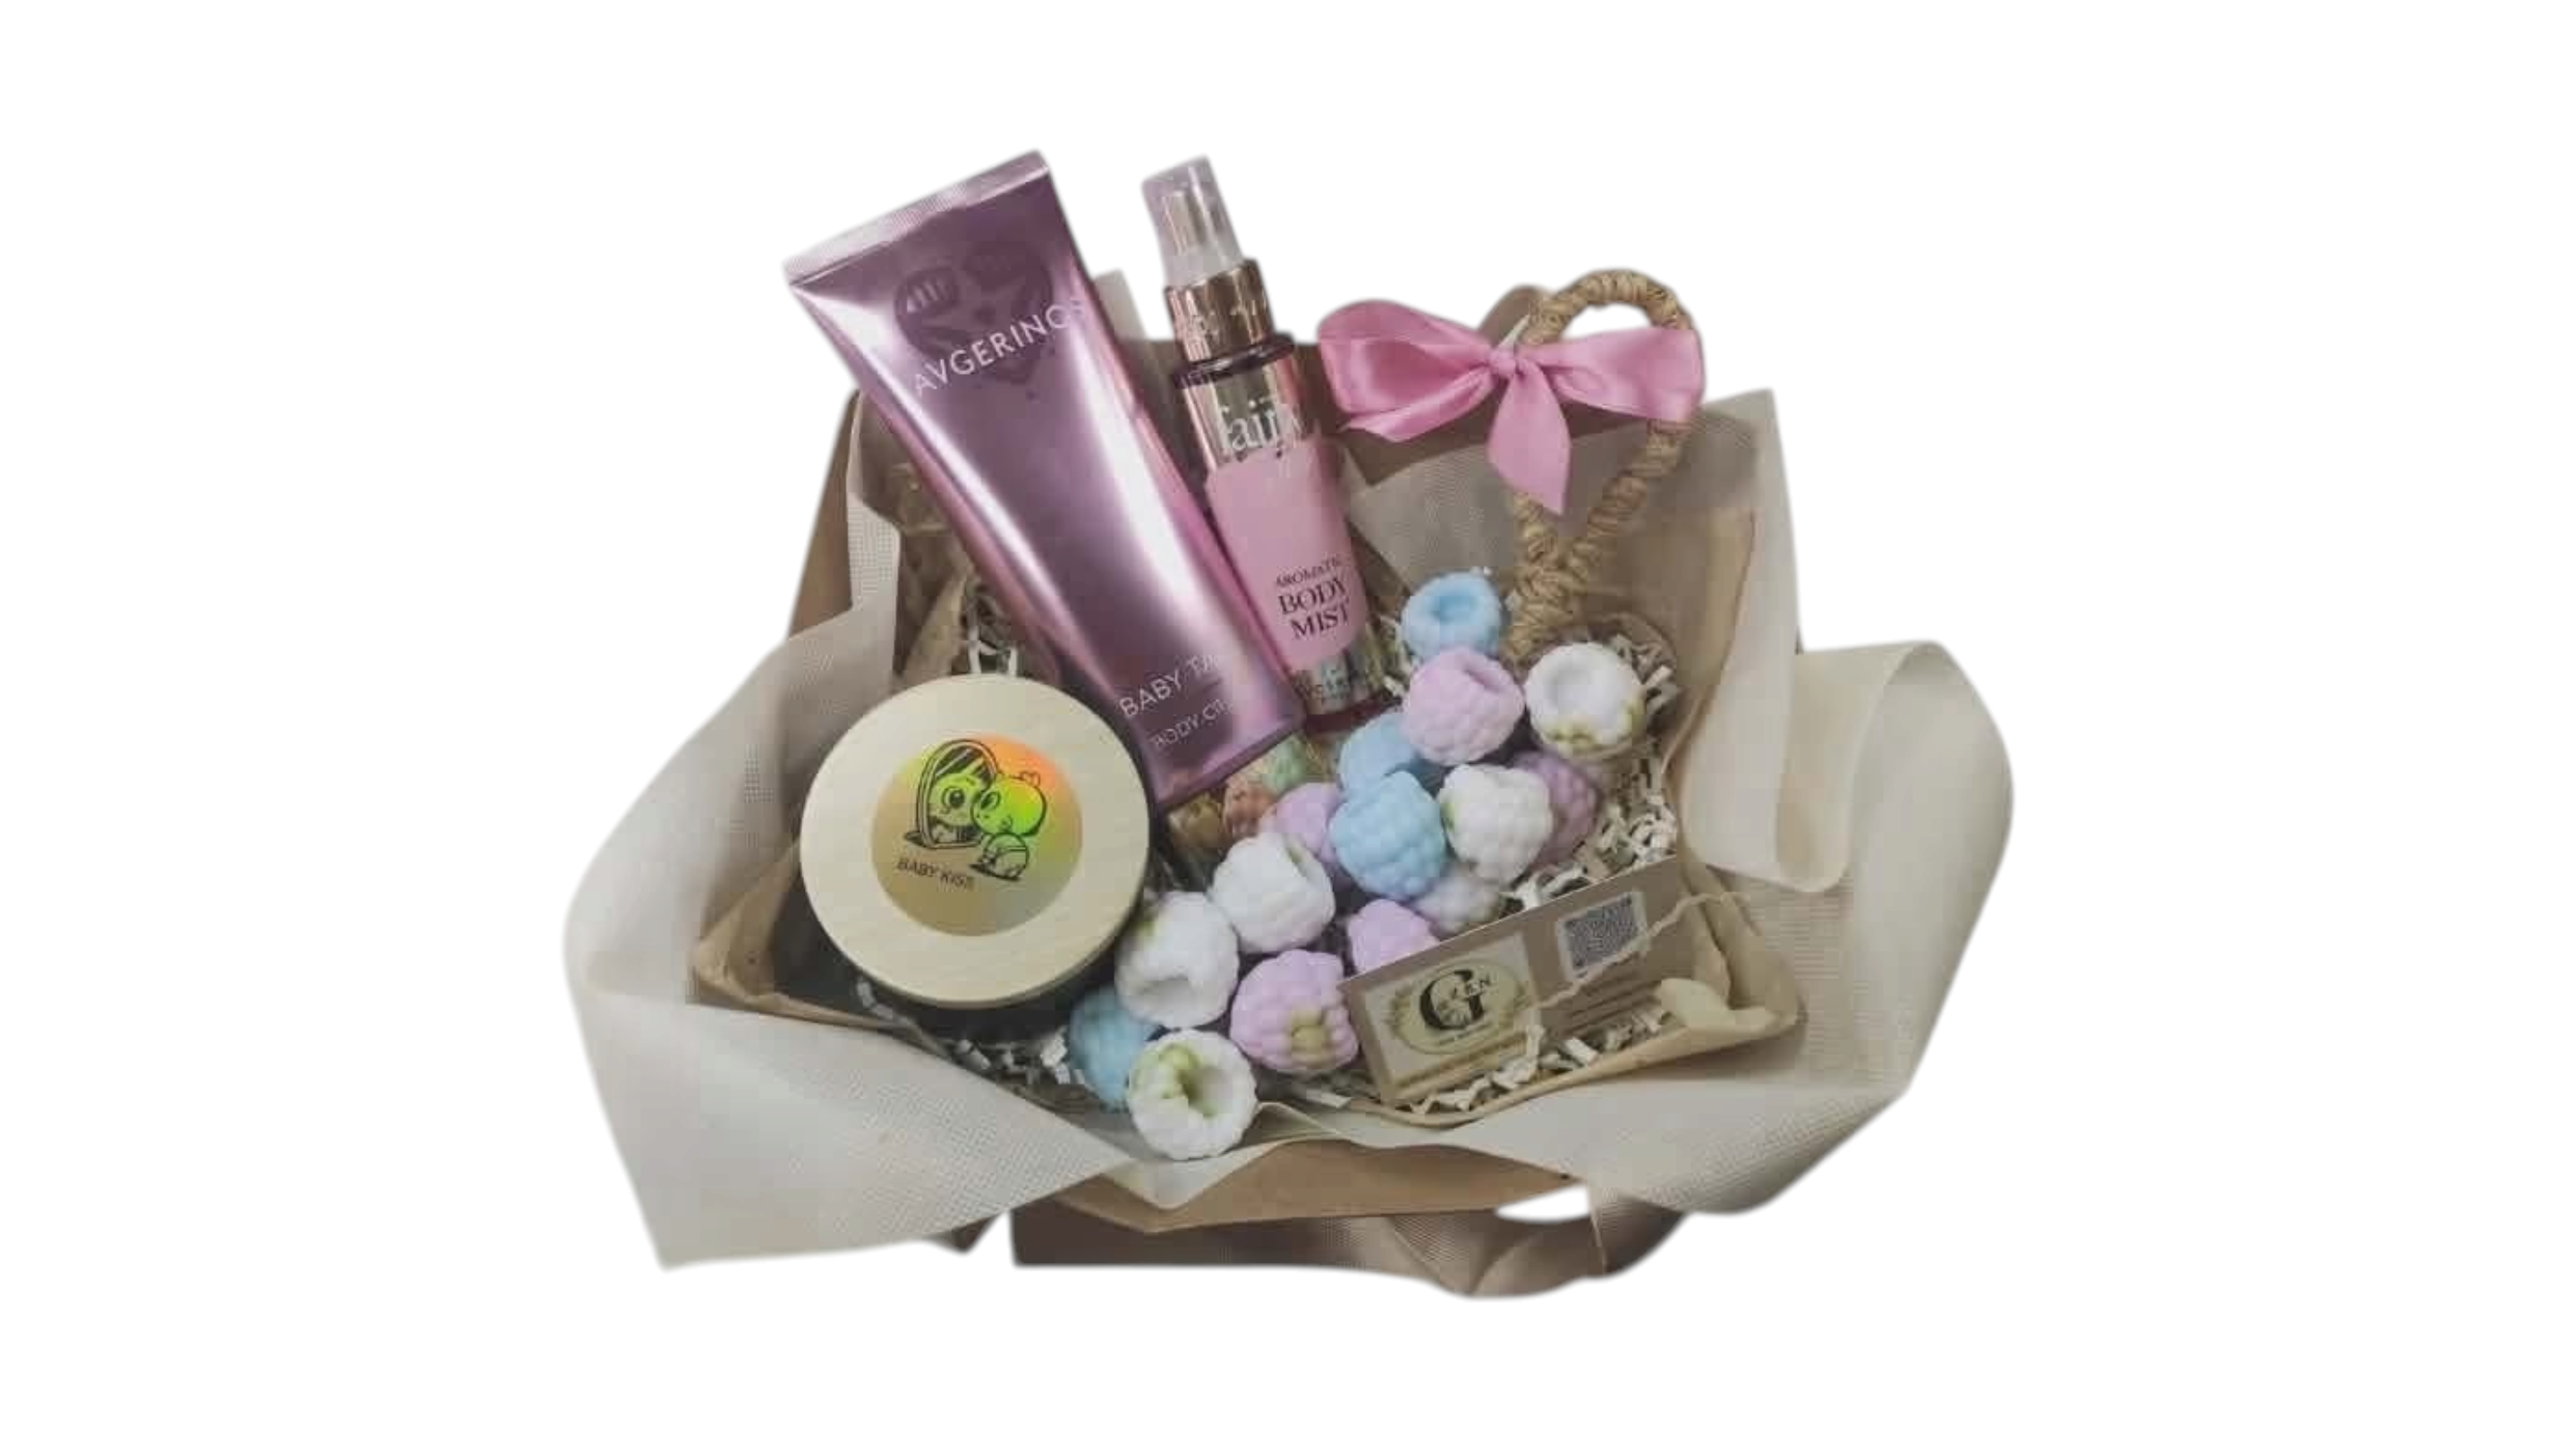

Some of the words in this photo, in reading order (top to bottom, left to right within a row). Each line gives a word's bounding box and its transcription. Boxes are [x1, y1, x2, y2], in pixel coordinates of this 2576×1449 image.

[1278, 577, 1346, 614] BODY
[1291, 597, 1350, 637] MIST
[1119, 670, 1182, 718] BABY
[896, 856, 940, 877] BABY
